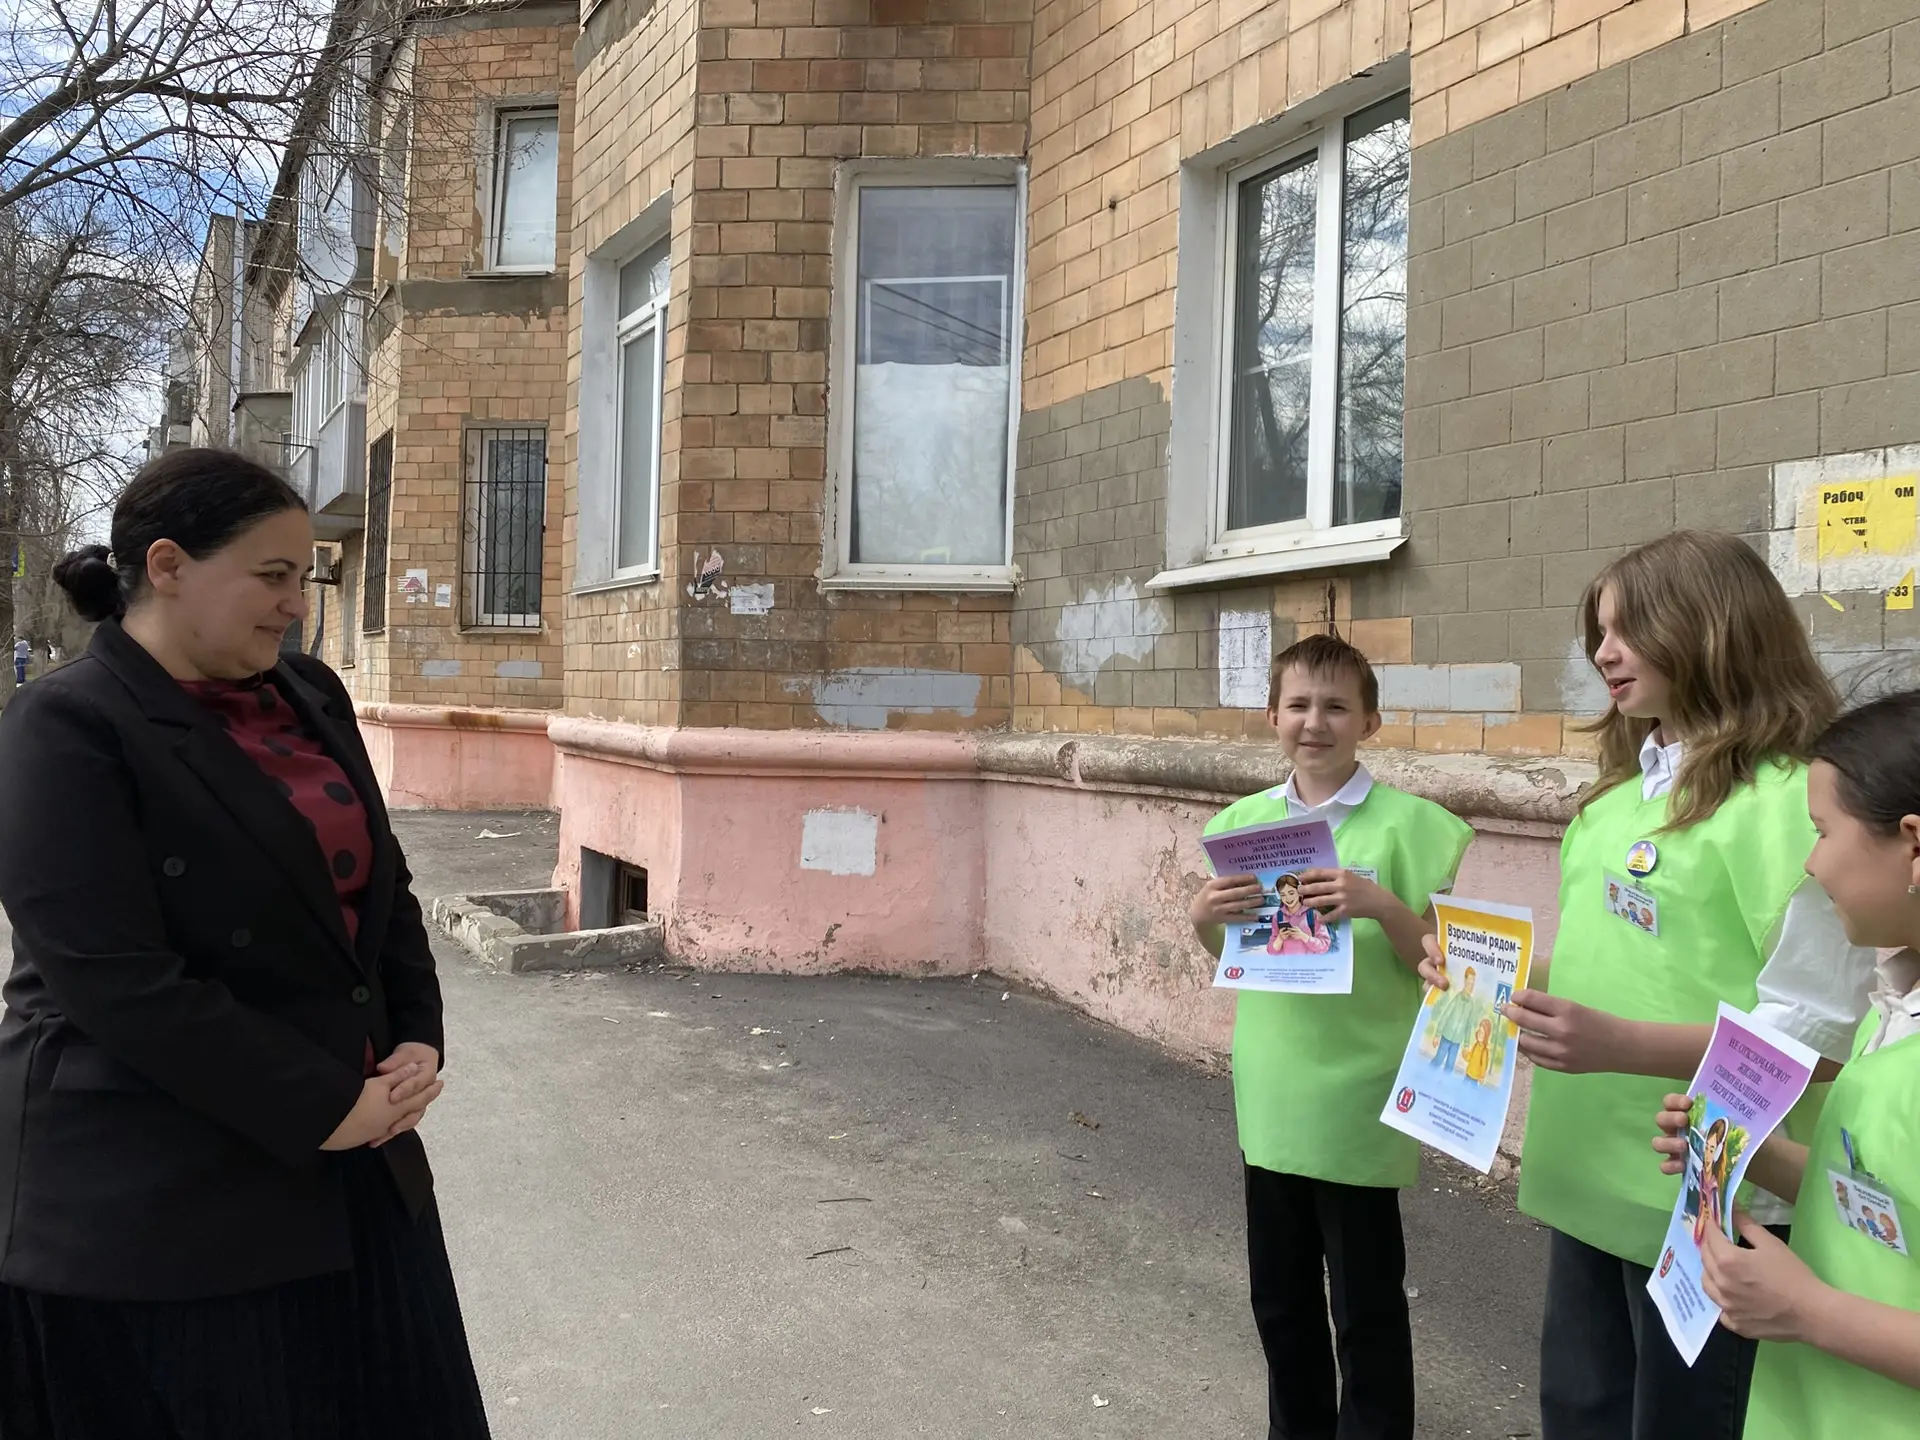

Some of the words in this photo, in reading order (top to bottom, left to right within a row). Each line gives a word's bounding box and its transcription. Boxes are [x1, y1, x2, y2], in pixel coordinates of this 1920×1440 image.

[1823, 490, 1864, 504] Рабоч
[1237, 831, 1299, 847] ОТКЛЮЧАЙСЯ
[1228, 855, 1262, 864] СНИМИ
[1240, 863, 1267, 871] УБЕРИ
[1268, 856, 1312, 868] ТЕЛЕФОН!
[1447, 923, 1488, 945] Взрослый
[1489, 936, 1516, 953] рядом
[1448, 942, 1496, 967] безопасный
[1496, 957, 1519, 974] путь!
[1738, 1043, 1782, 1082] ОТКЛЮЧАЙСЯ
[1710, 1079, 1729, 1101] УБЕРИ
